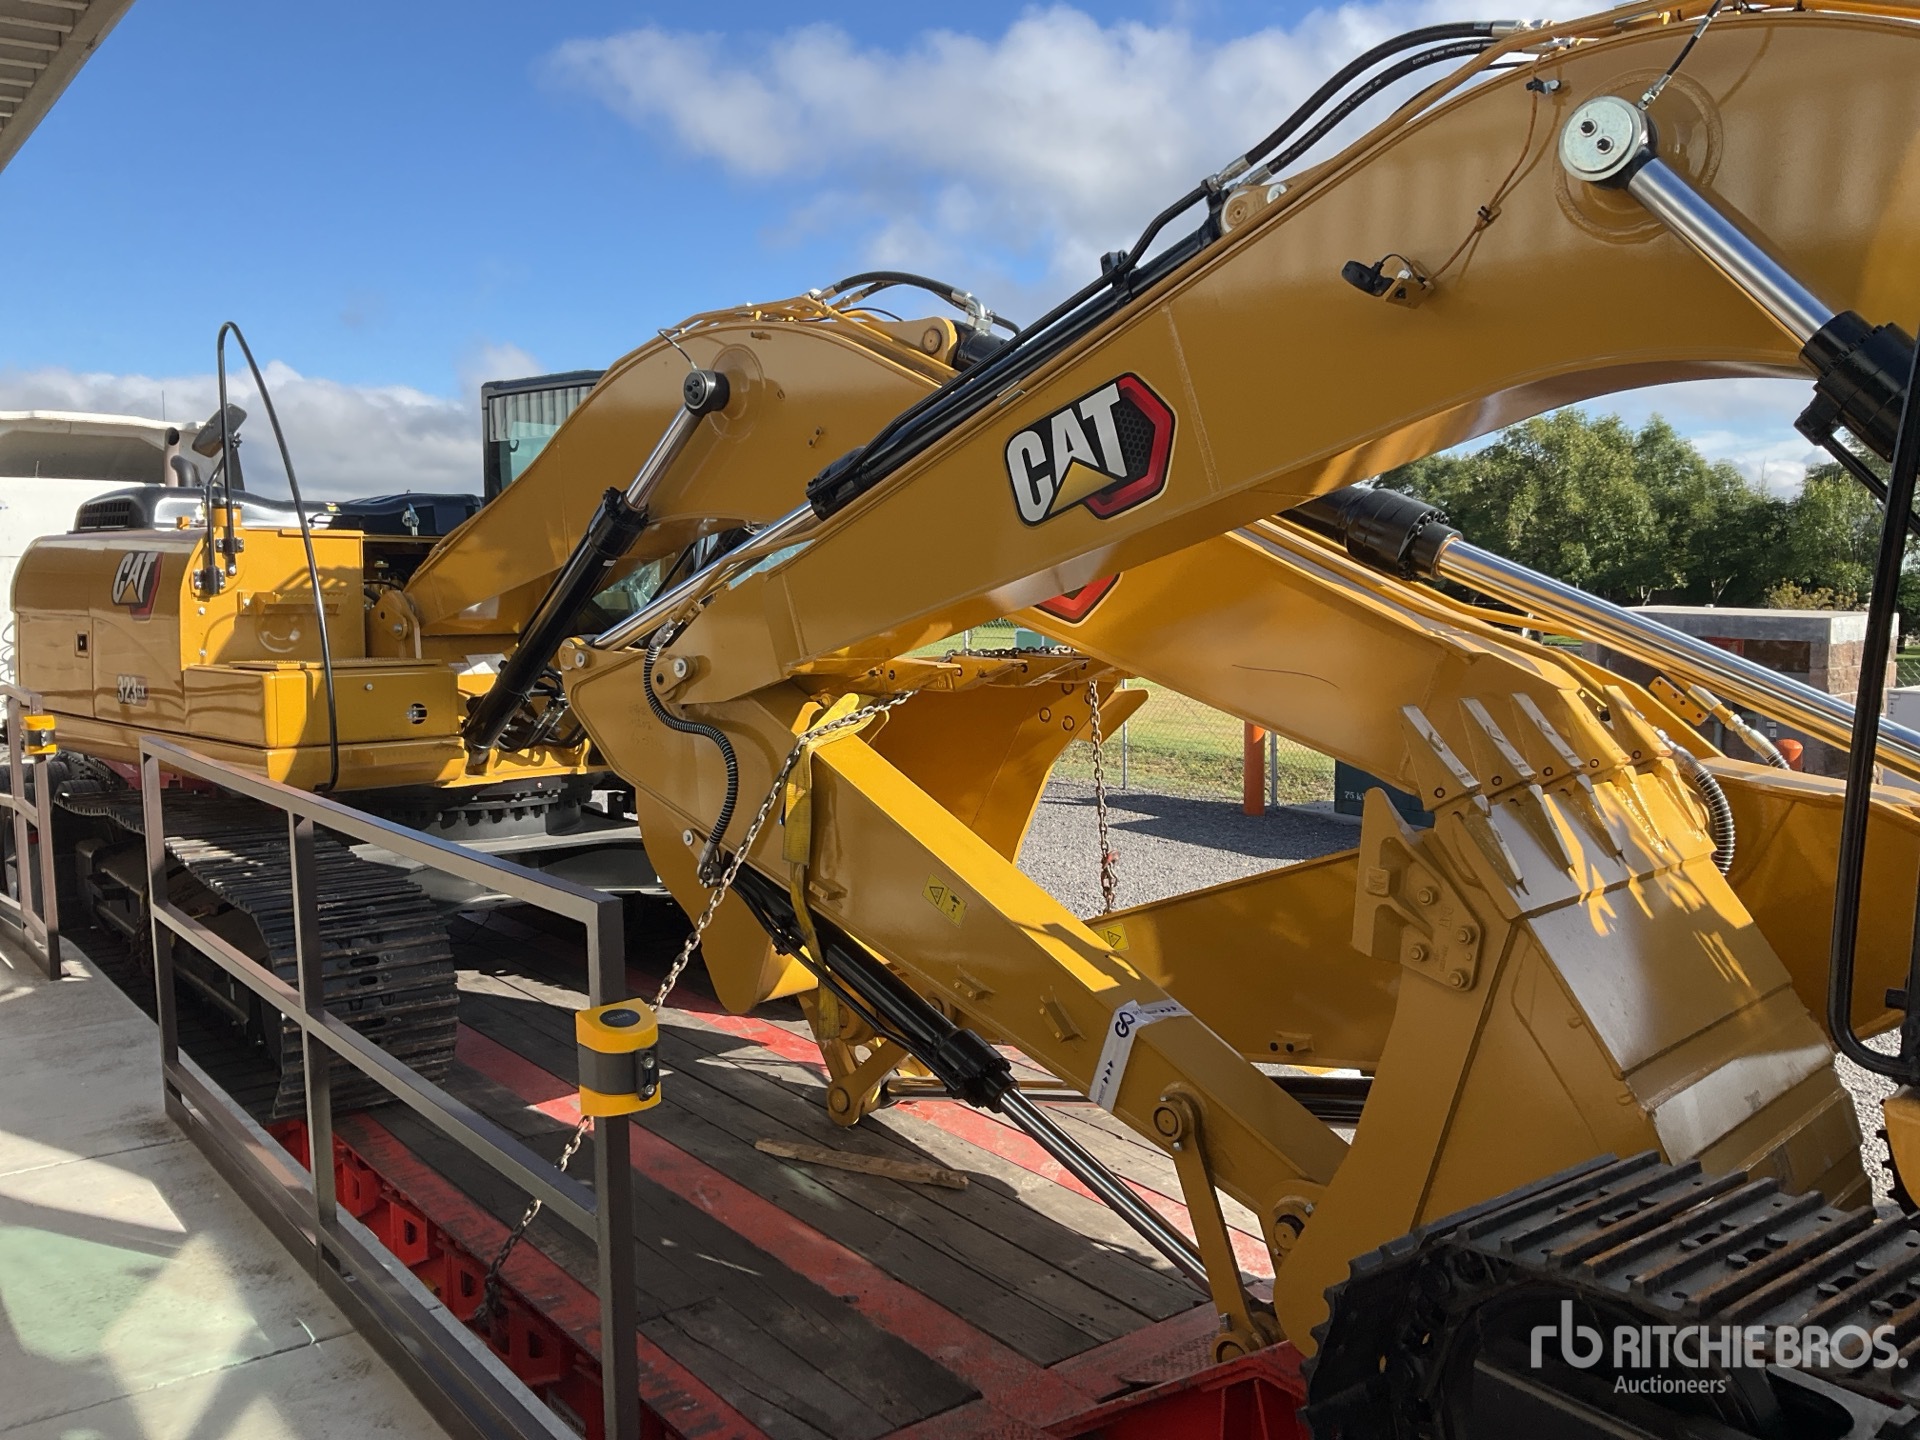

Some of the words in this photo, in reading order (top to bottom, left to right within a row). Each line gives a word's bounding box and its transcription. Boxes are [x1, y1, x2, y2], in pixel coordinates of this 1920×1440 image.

[1007, 383, 1127, 522] CAT
[113, 552, 158, 604] CAT
[1344, 790, 1355, 800] 75
